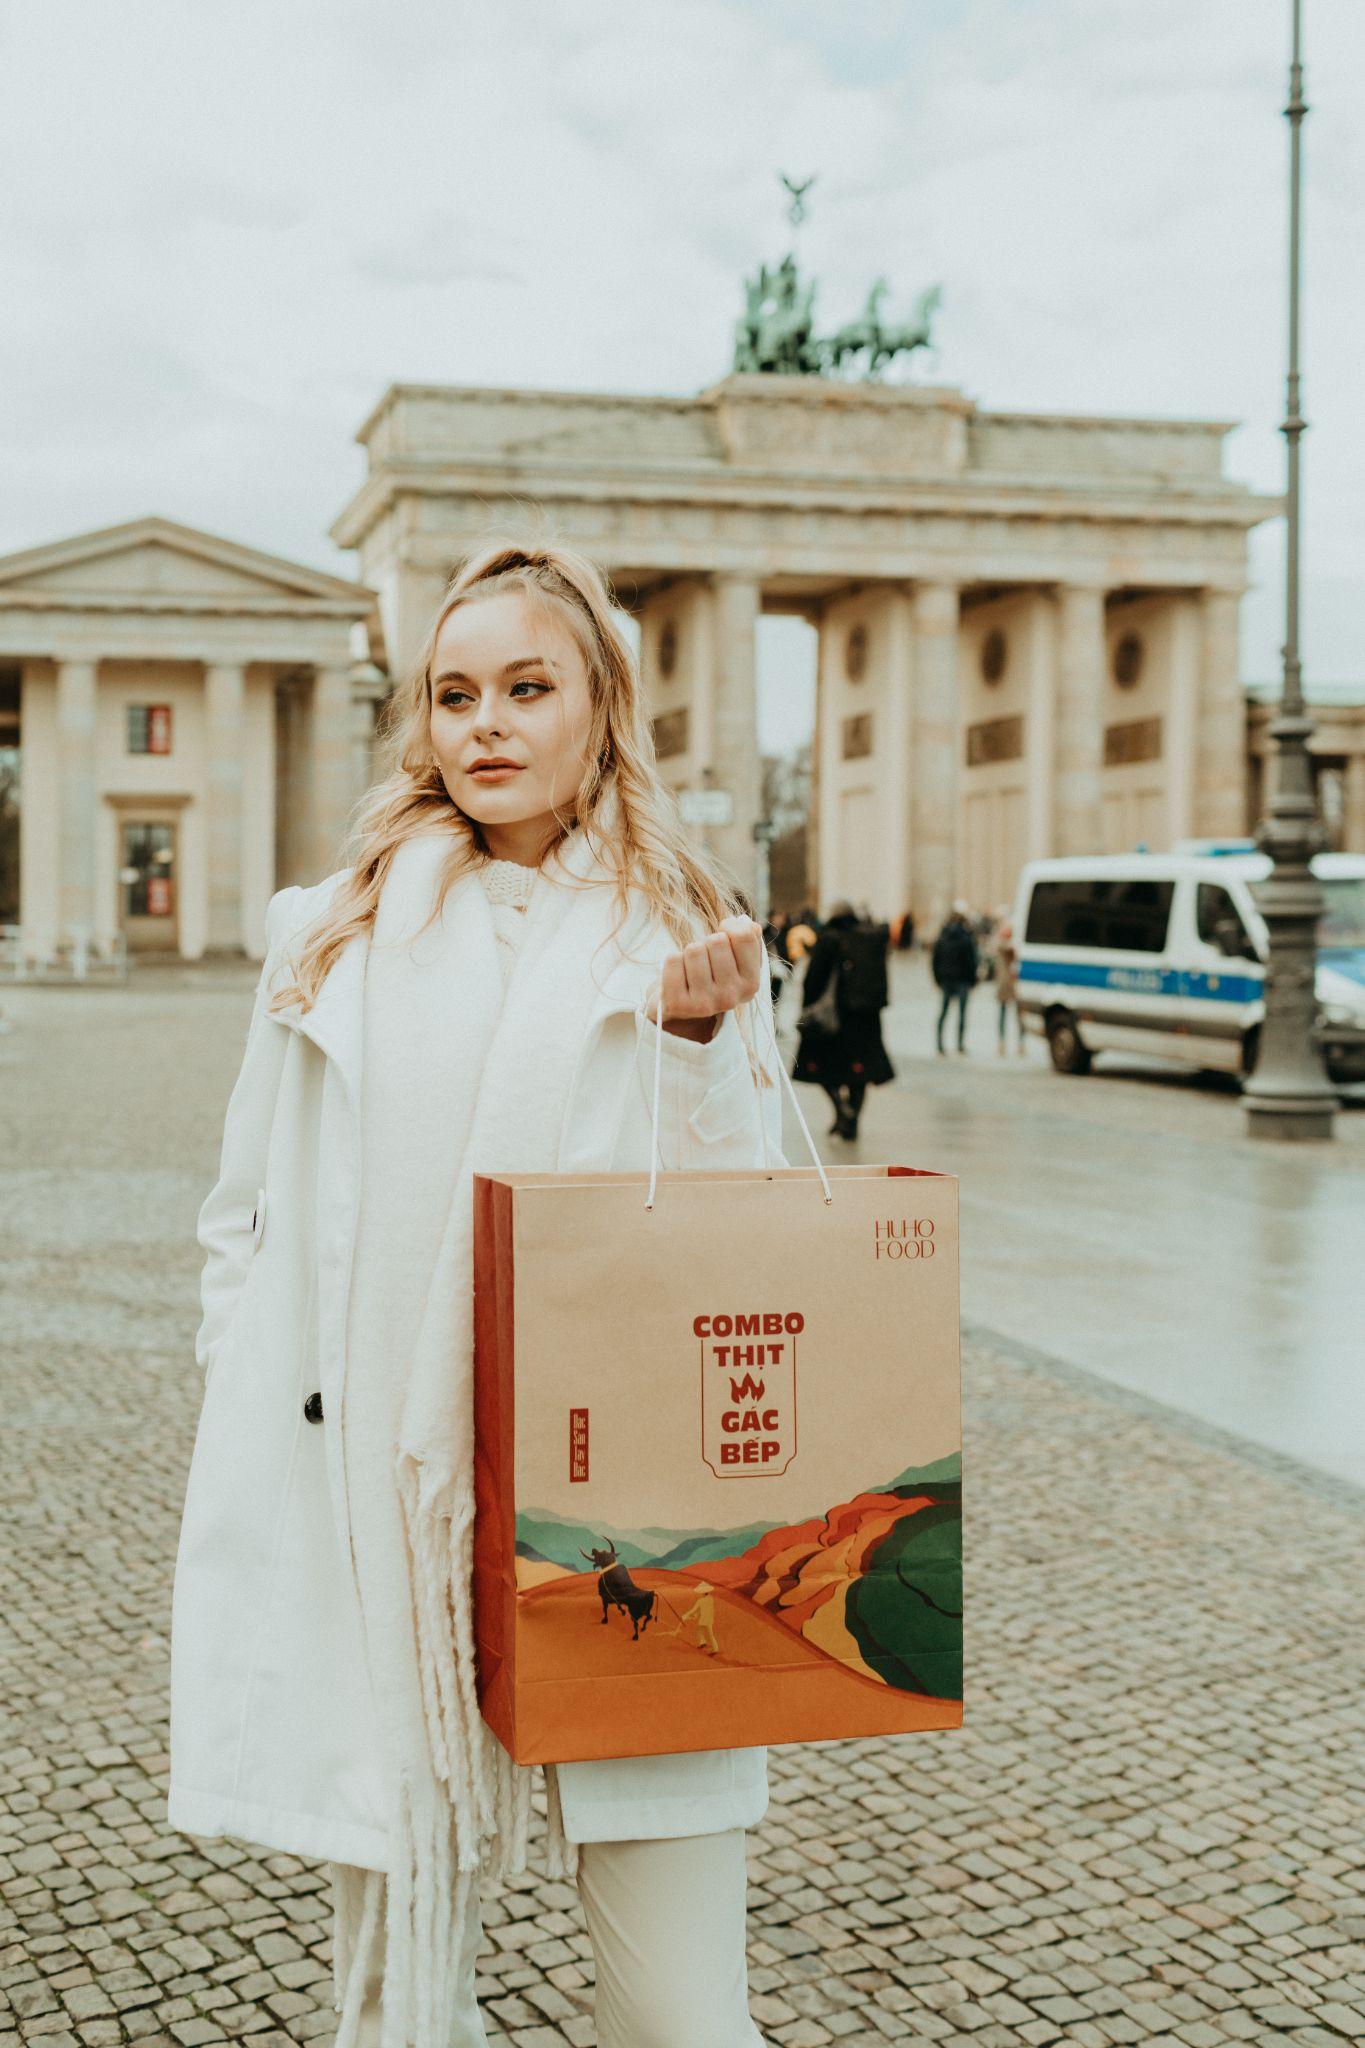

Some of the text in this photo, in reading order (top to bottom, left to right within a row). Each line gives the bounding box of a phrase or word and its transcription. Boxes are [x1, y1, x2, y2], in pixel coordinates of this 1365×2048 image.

[875, 1219, 935, 1239] HUHO
[875, 1240, 935, 1260] FOOD
[693, 1312, 805, 1338] COMBO
[713, 1344, 785, 1370] THỊT
[721, 1406, 779, 1433] GÁC
[720, 1436, 780, 1465] BẾP
